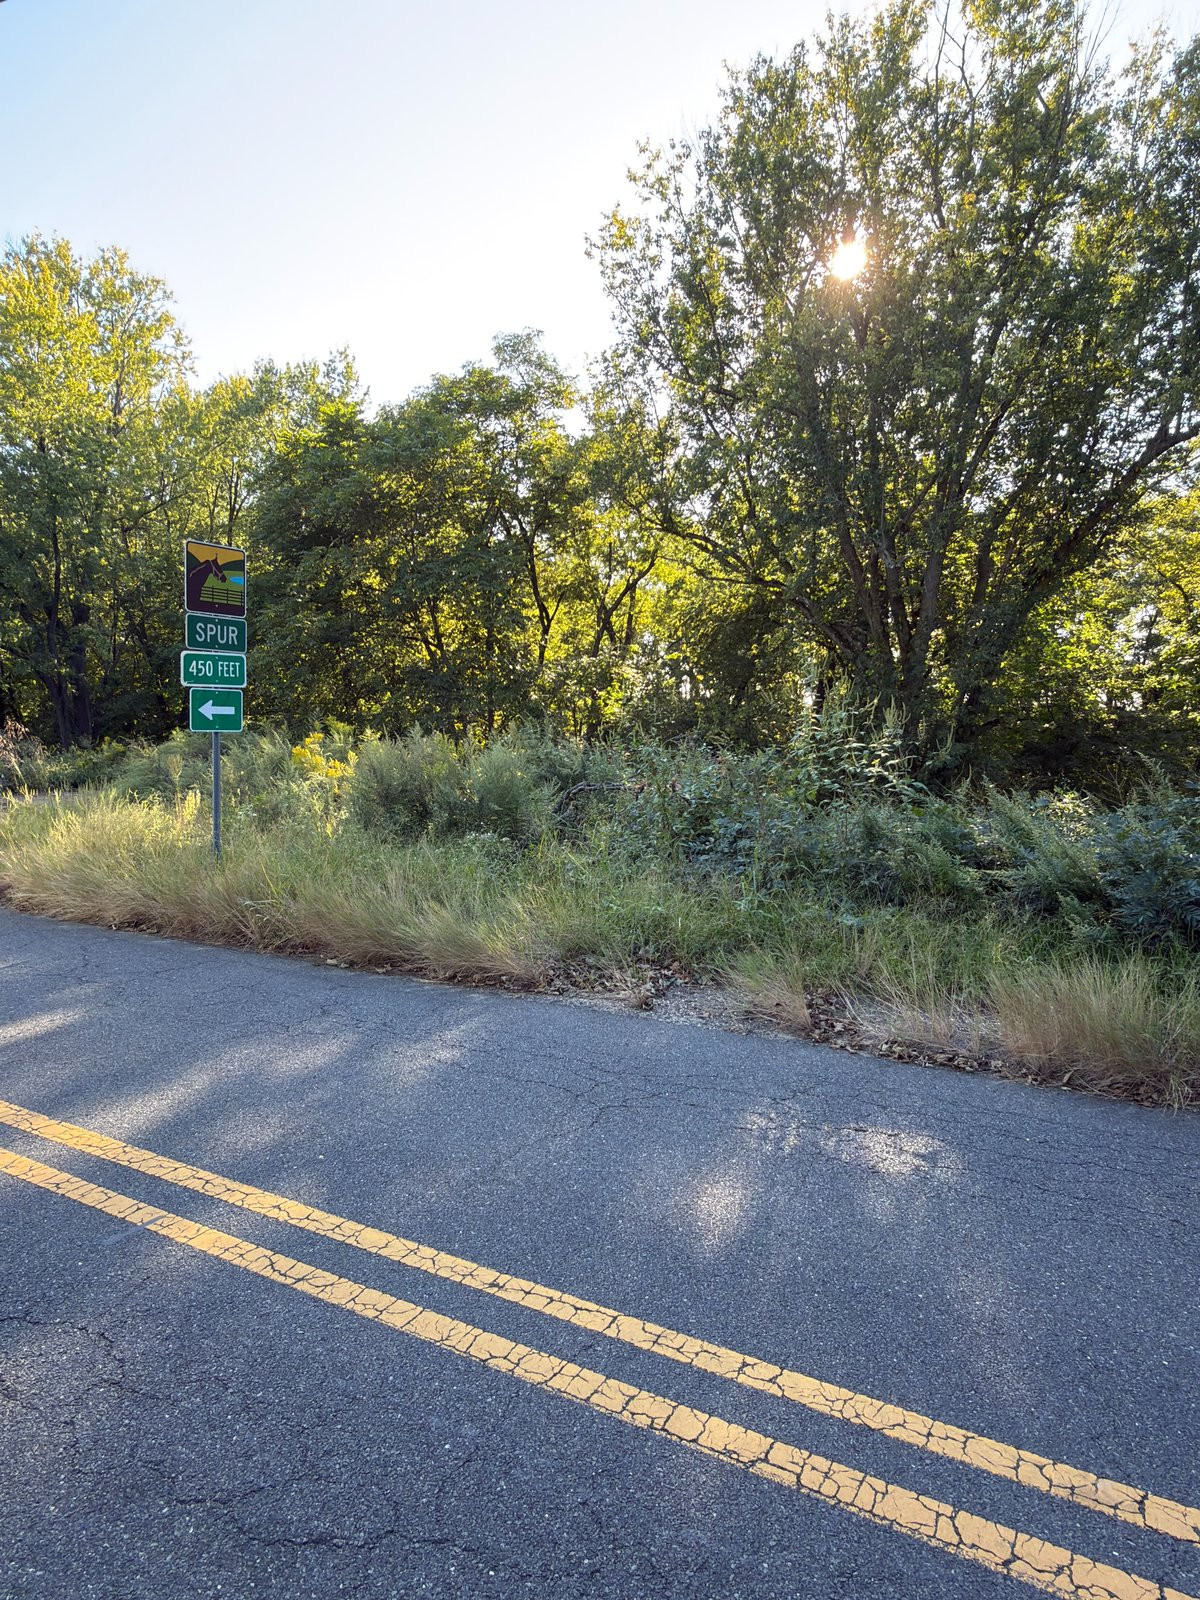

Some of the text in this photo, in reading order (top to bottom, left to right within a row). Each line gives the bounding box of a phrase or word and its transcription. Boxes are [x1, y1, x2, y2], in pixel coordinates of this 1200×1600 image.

[195, 622, 238, 645] SPUR
[189, 660, 240, 678] 450 FEET
